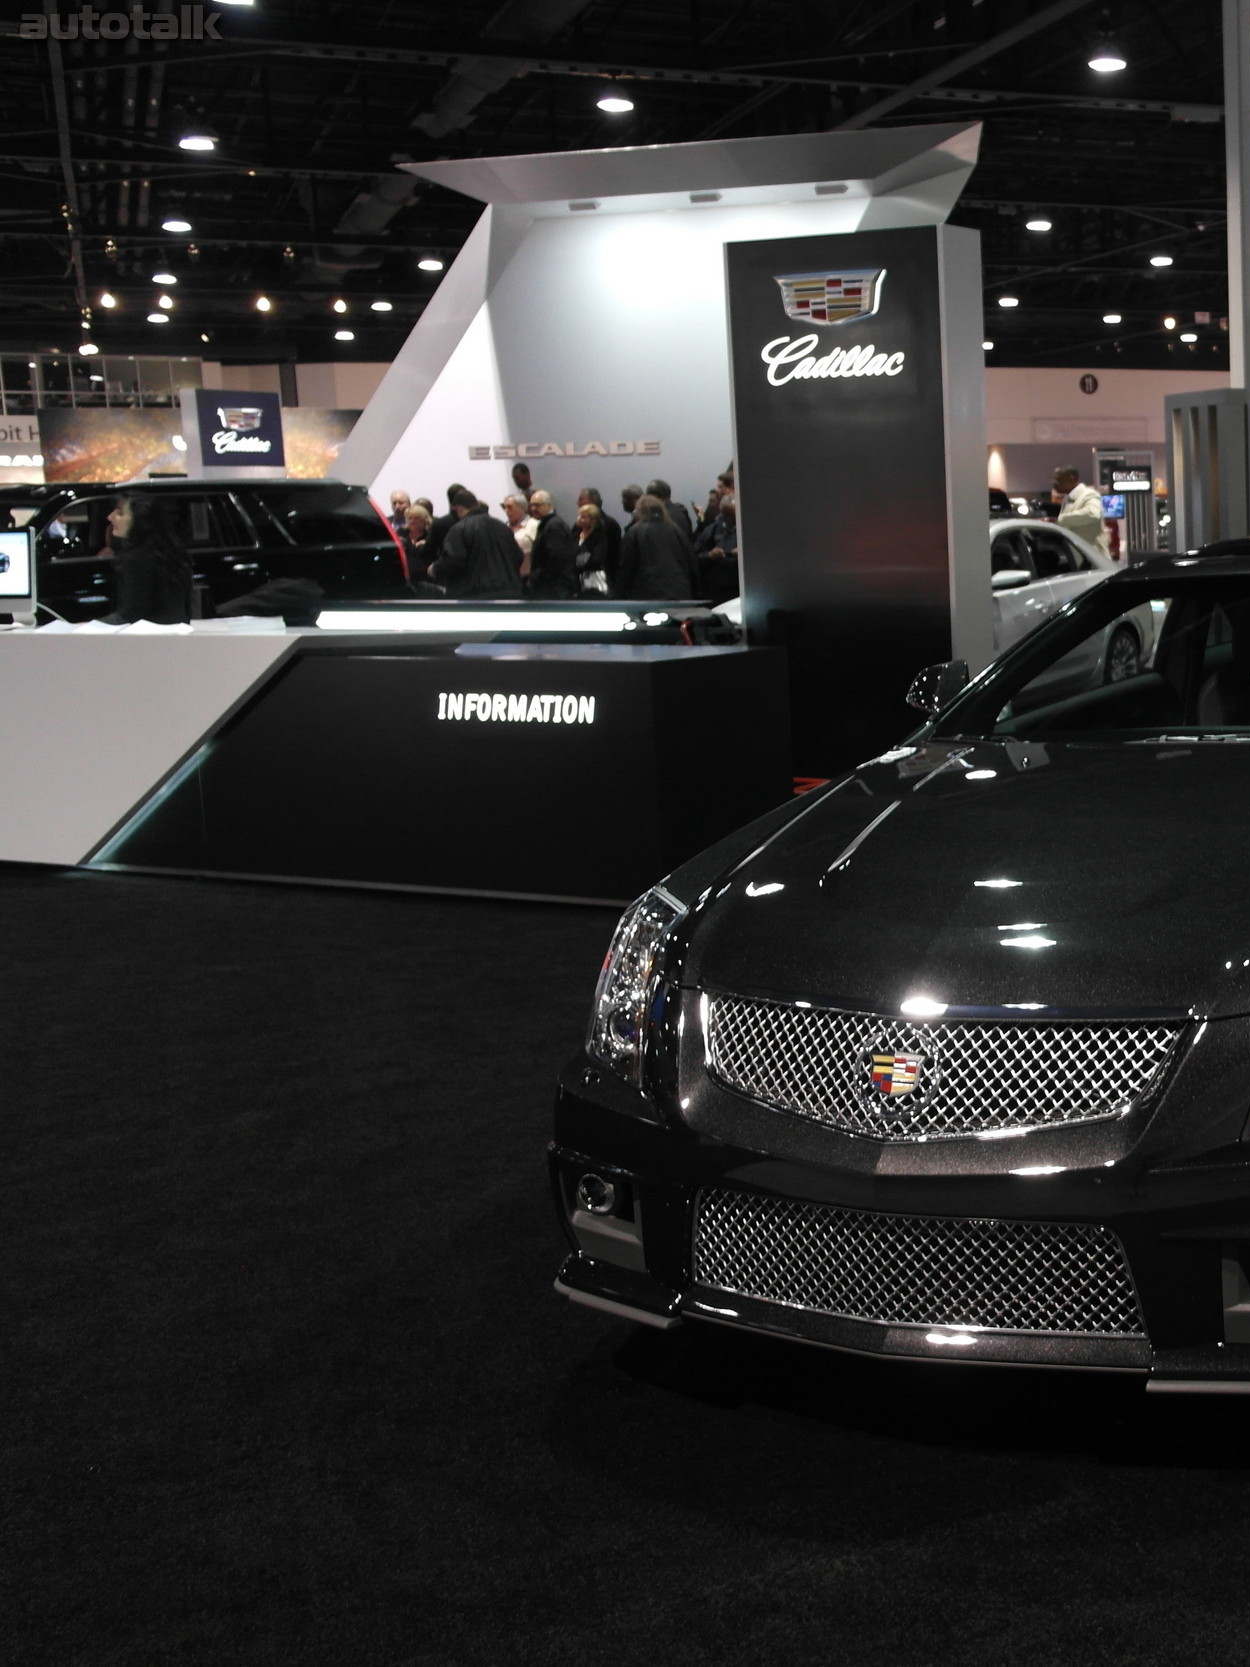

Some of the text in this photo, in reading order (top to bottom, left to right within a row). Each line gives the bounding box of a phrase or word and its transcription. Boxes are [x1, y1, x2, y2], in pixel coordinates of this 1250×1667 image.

[761, 333, 905, 387] Cadillac
[212, 430, 272, 454] Cadillac
[468, 440, 661, 460] ESCALADE
[437, 692, 596, 725] INFORMATION
